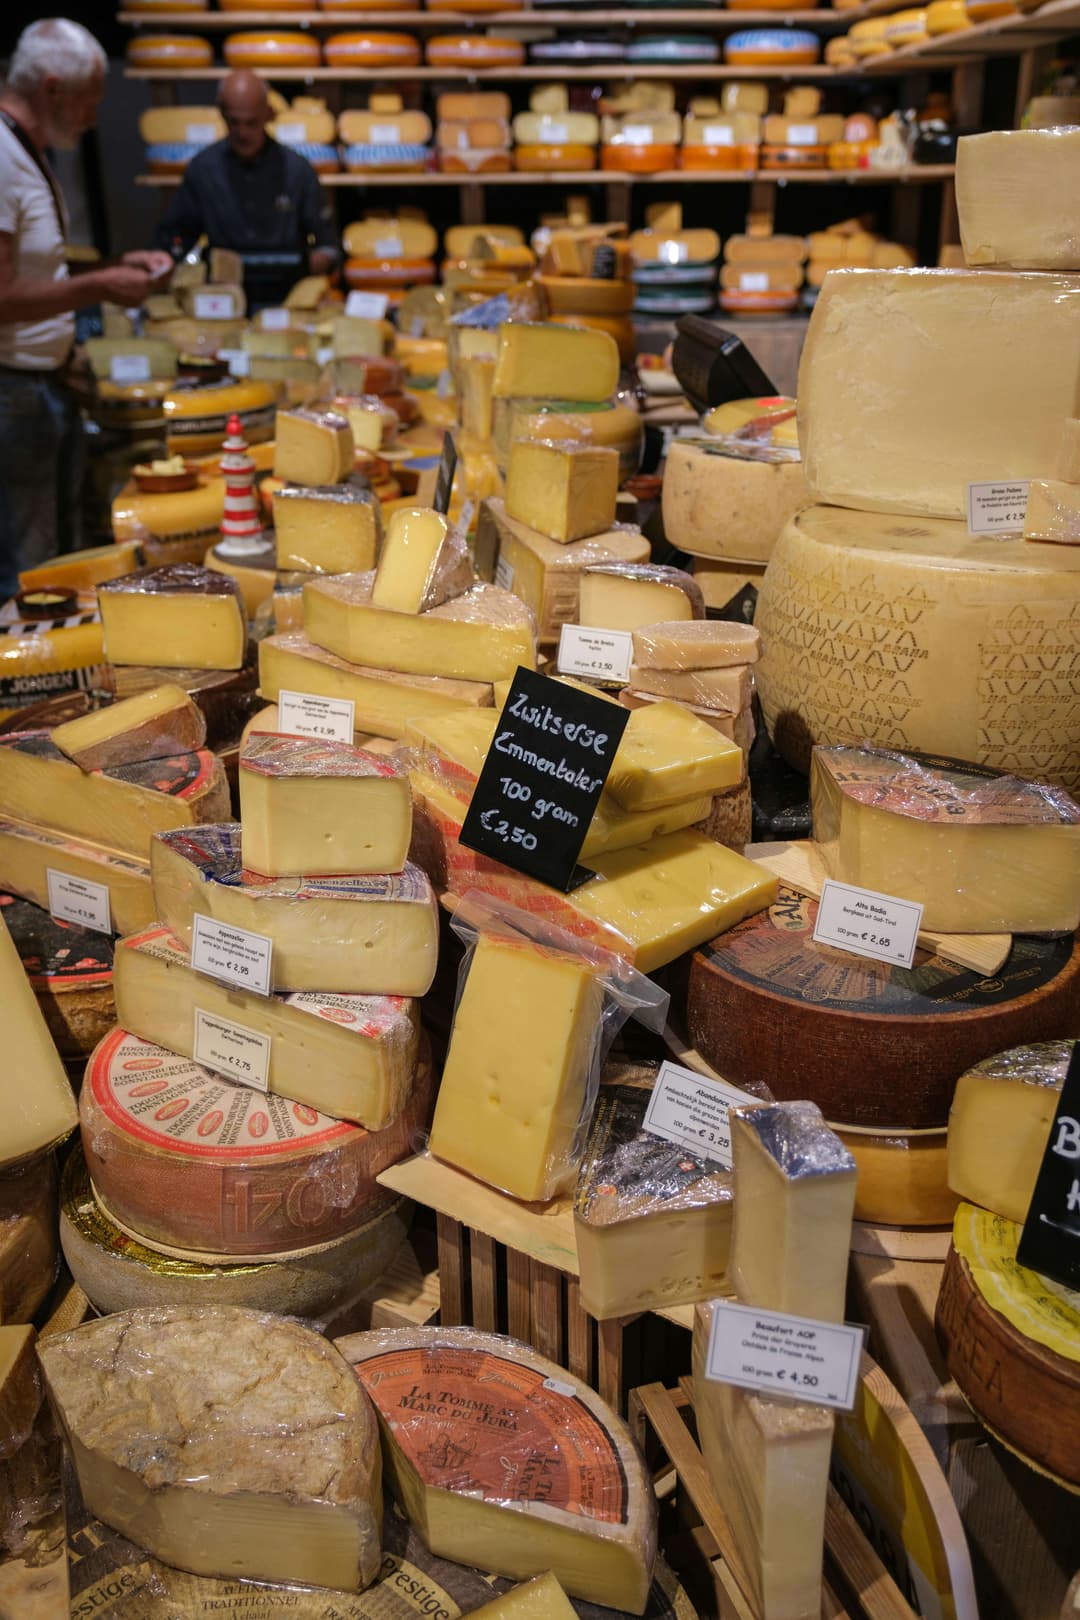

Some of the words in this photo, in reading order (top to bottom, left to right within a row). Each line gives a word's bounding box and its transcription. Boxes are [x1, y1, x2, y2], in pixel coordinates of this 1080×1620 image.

[508, 692, 609, 756] Zwitserse
[494, 731, 603, 793] Emmentaler
[500, 777, 532, 801] 100
[531, 799, 579, 827] gram
[480, 809, 538, 851] €2,50
[870, 905, 887, 916] Badia
[861, 932, 868, 940] €
[226, 961, 232, 969] €
[233, 963, 249, 975] 2,95
[112, 1062, 196, 1082] TOGGENBURGER
[228, 1056, 234, 1064] €
[235, 1059, 251, 1071] 2,75
[683, 1126, 697, 1134] gram
[698, 1129, 706, 1137] €
[708, 1132, 730, 1148] 3,25
[755, 1320, 794, 1337] Beaufort
[776, 1370, 786, 1380] €
[790, 1372, 819, 1387] 4,50
[409, 1385, 431, 1400] LA
[438, 1391, 495, 1413] TOMME
[397, 1395, 448, 1416] MARC
[451, 1410, 472, 1420] DU
[475, 1412, 518, 1431] JURA
[71, 1574, 135, 1620] estige
